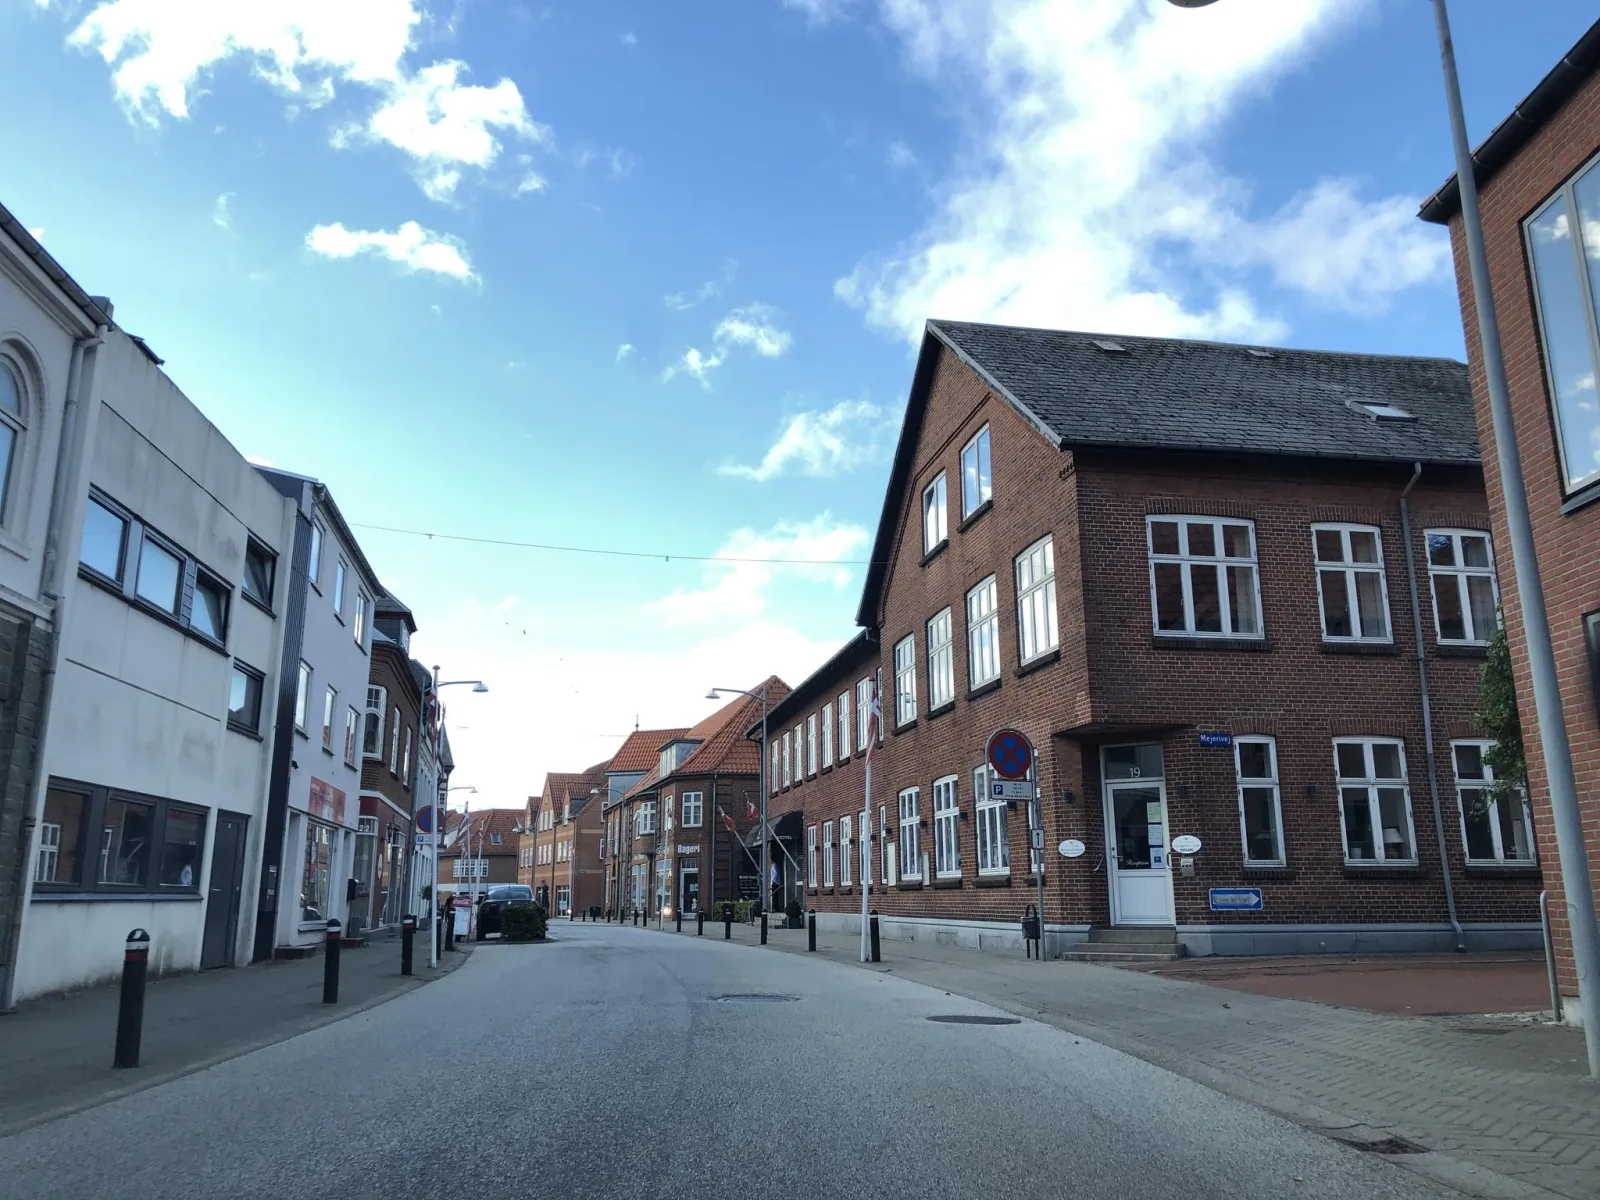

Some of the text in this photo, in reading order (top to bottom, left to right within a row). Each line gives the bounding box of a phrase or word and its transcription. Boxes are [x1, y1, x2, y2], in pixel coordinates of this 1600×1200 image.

[1200, 734, 1231, 745] Mejerivej
[1129, 766, 1141, 778] 19
[359, 824, 370, 832] 22
